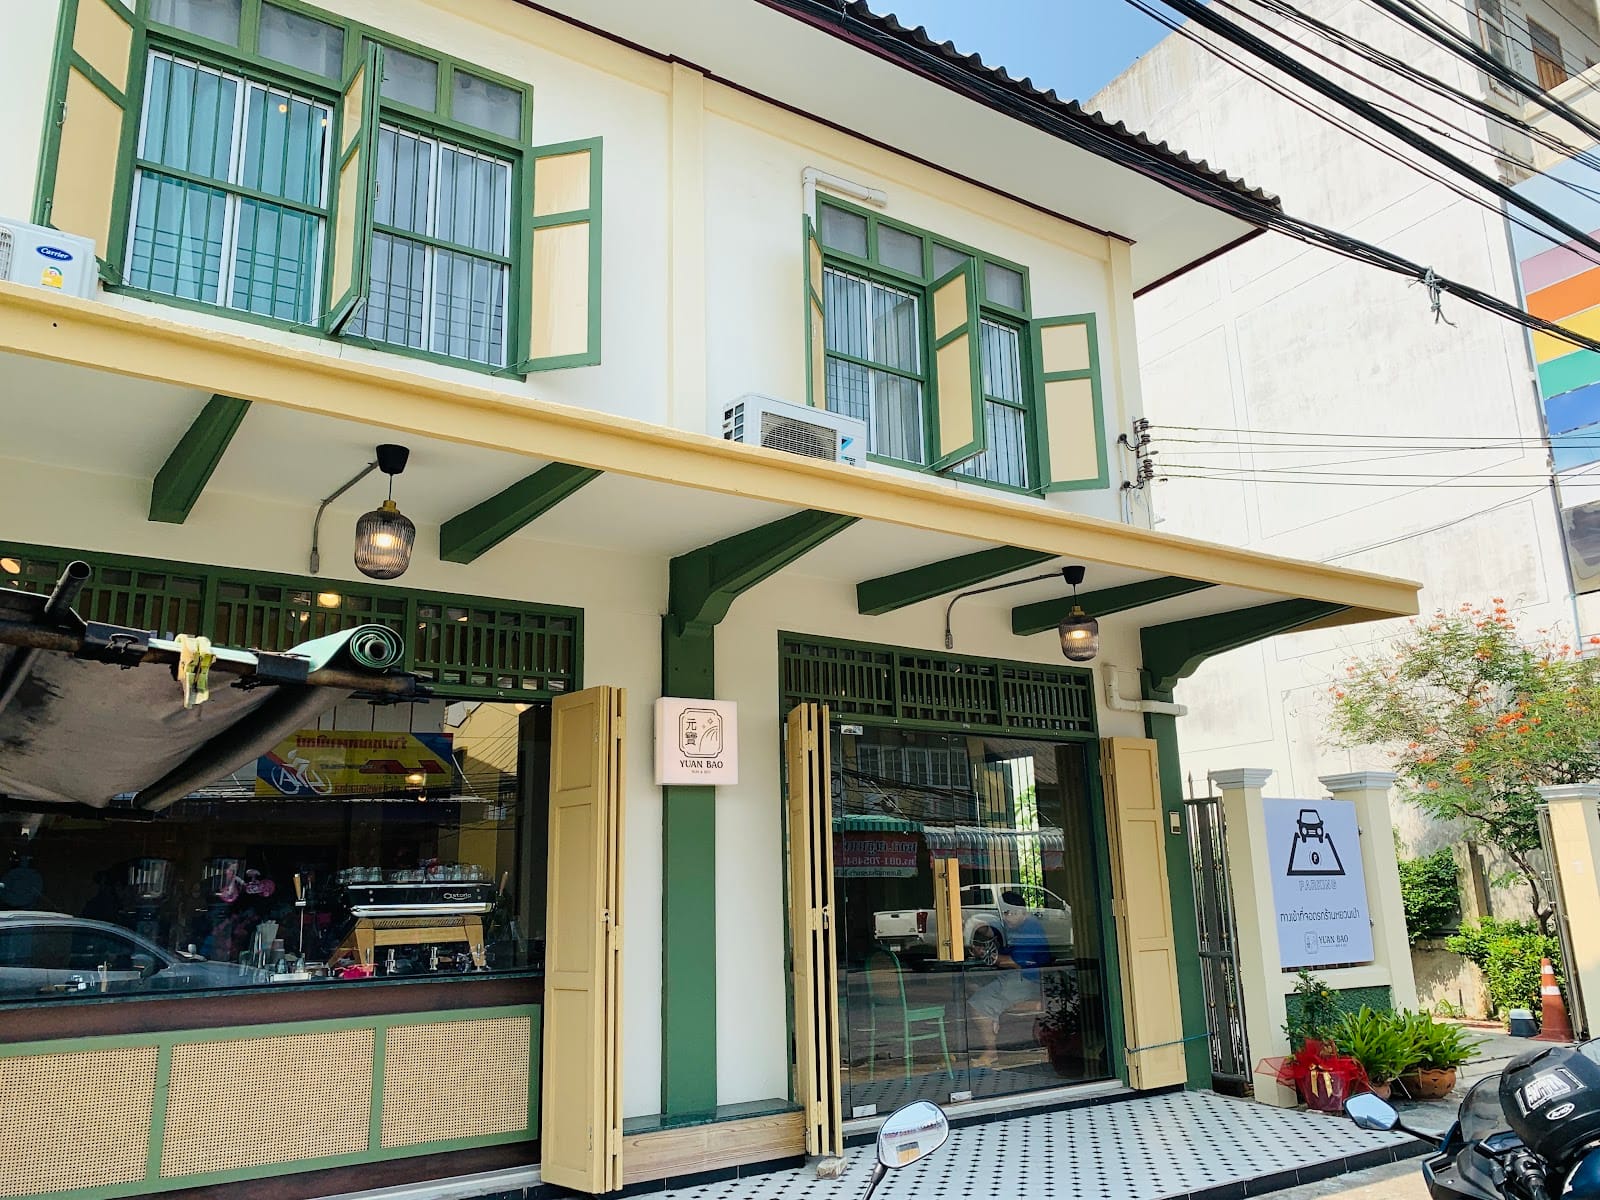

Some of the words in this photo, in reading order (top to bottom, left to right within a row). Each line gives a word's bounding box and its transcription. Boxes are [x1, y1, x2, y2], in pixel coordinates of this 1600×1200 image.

[41, 247, 70, 260] Carrier
[680, 760, 703, 768] YUAN
[706, 760, 724, 769] BAO
[1299, 880, 1337, 891] PARKING
[1318, 935, 1335, 944] YUAN
[1336, 934, 1348, 943] BAO
